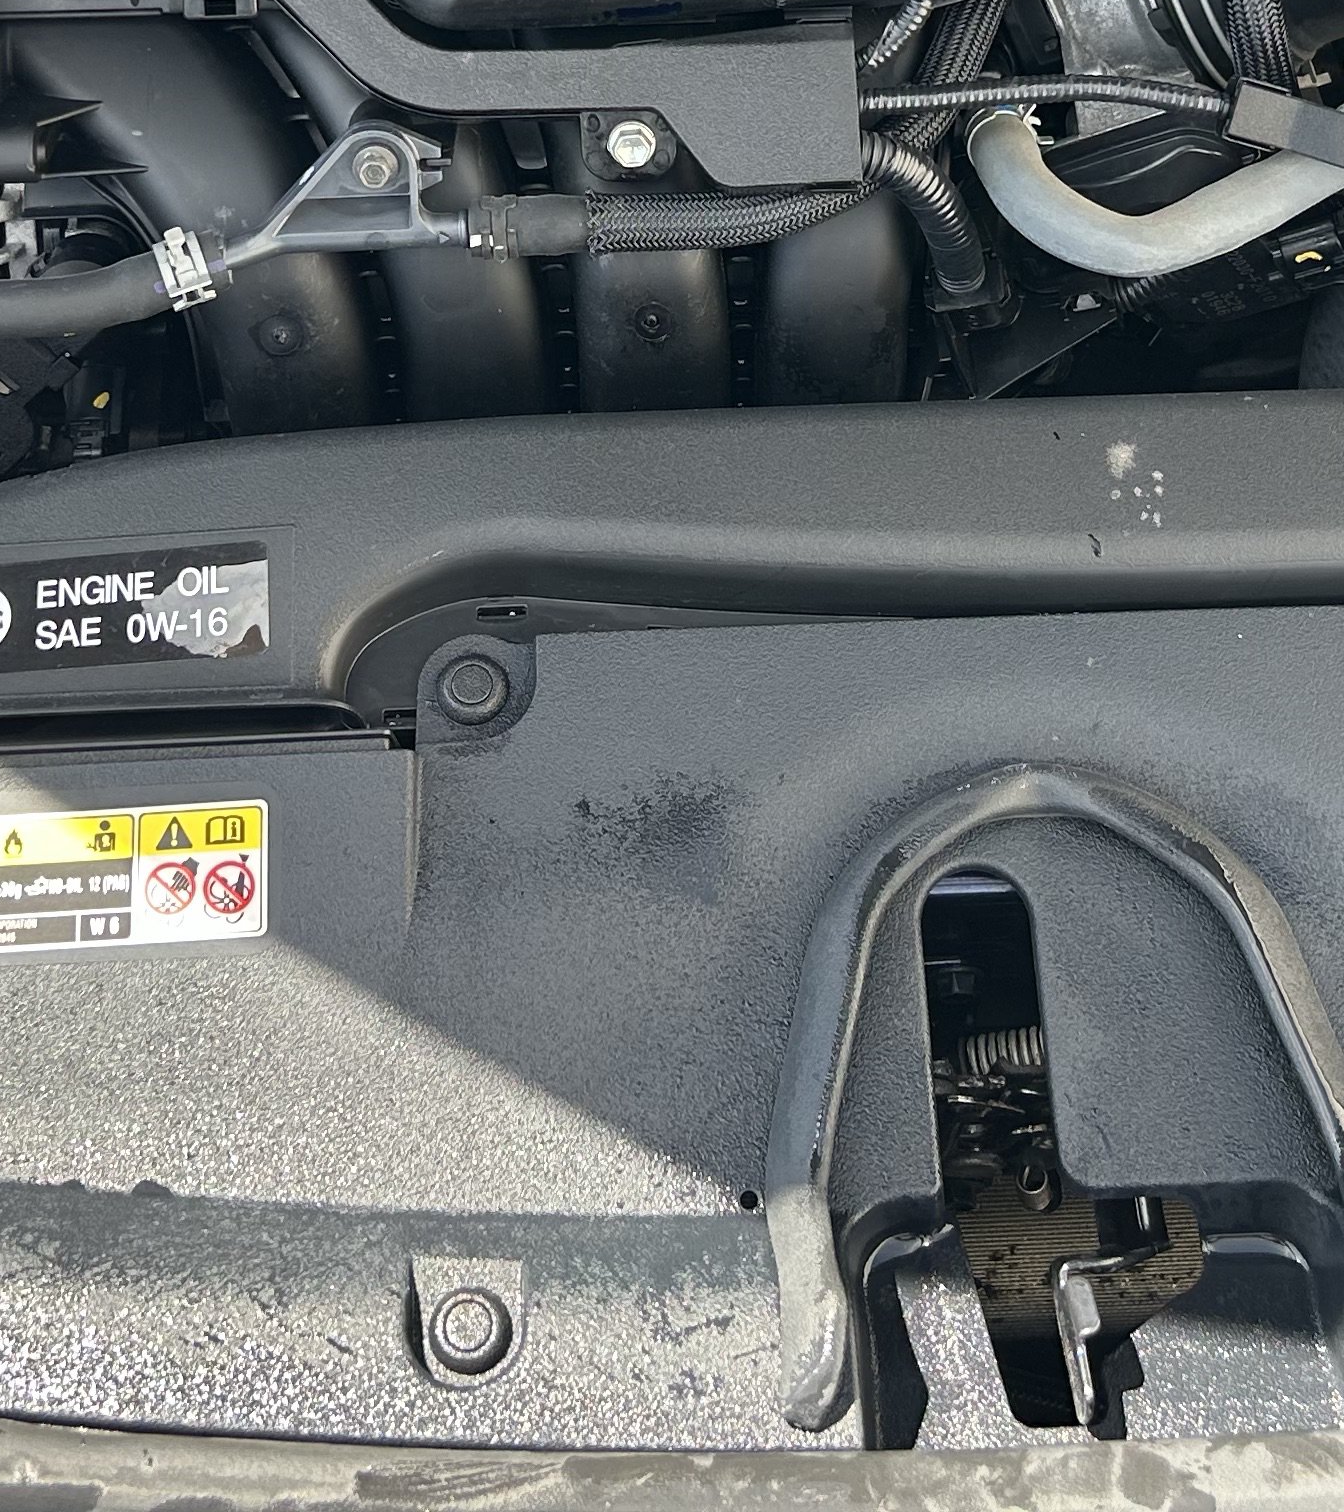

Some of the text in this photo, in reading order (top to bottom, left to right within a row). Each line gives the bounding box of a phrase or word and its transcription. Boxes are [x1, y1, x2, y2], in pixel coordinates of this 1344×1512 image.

[35, 564, 229, 610] ENGINE OIL
[34, 607, 228, 650] SAE 0W-16
[90, 917, 120, 936] W 6
